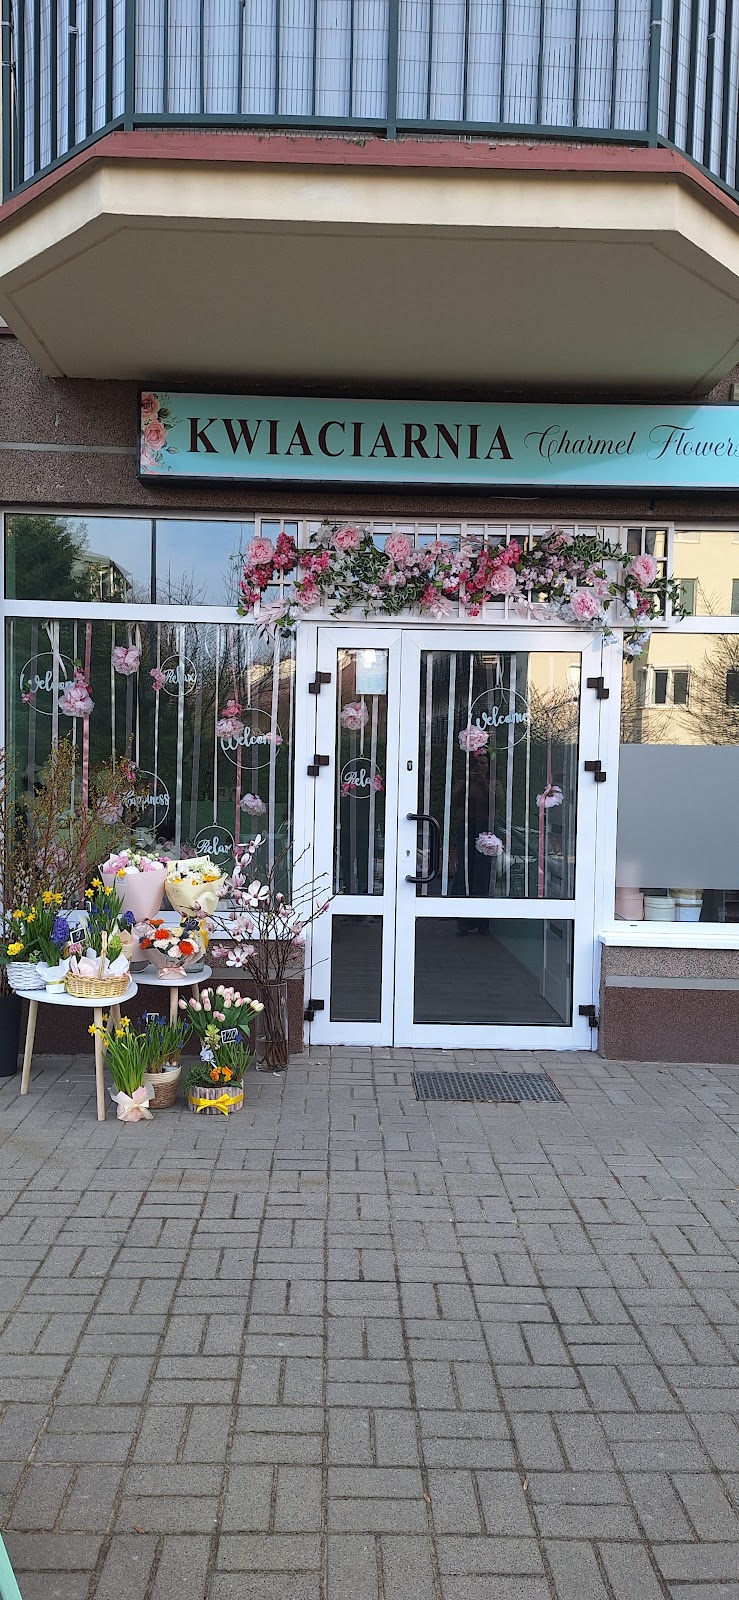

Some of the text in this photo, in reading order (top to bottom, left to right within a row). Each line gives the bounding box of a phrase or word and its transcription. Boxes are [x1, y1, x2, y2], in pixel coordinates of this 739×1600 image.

[187, 416, 513, 460] KWIACIARNIA
[524, 424, 637, 464] Charmel
[220, 726, 271, 750] Welcom
[344, 768, 371, 787] Rela
[196, 836, 232, 856] Relax
